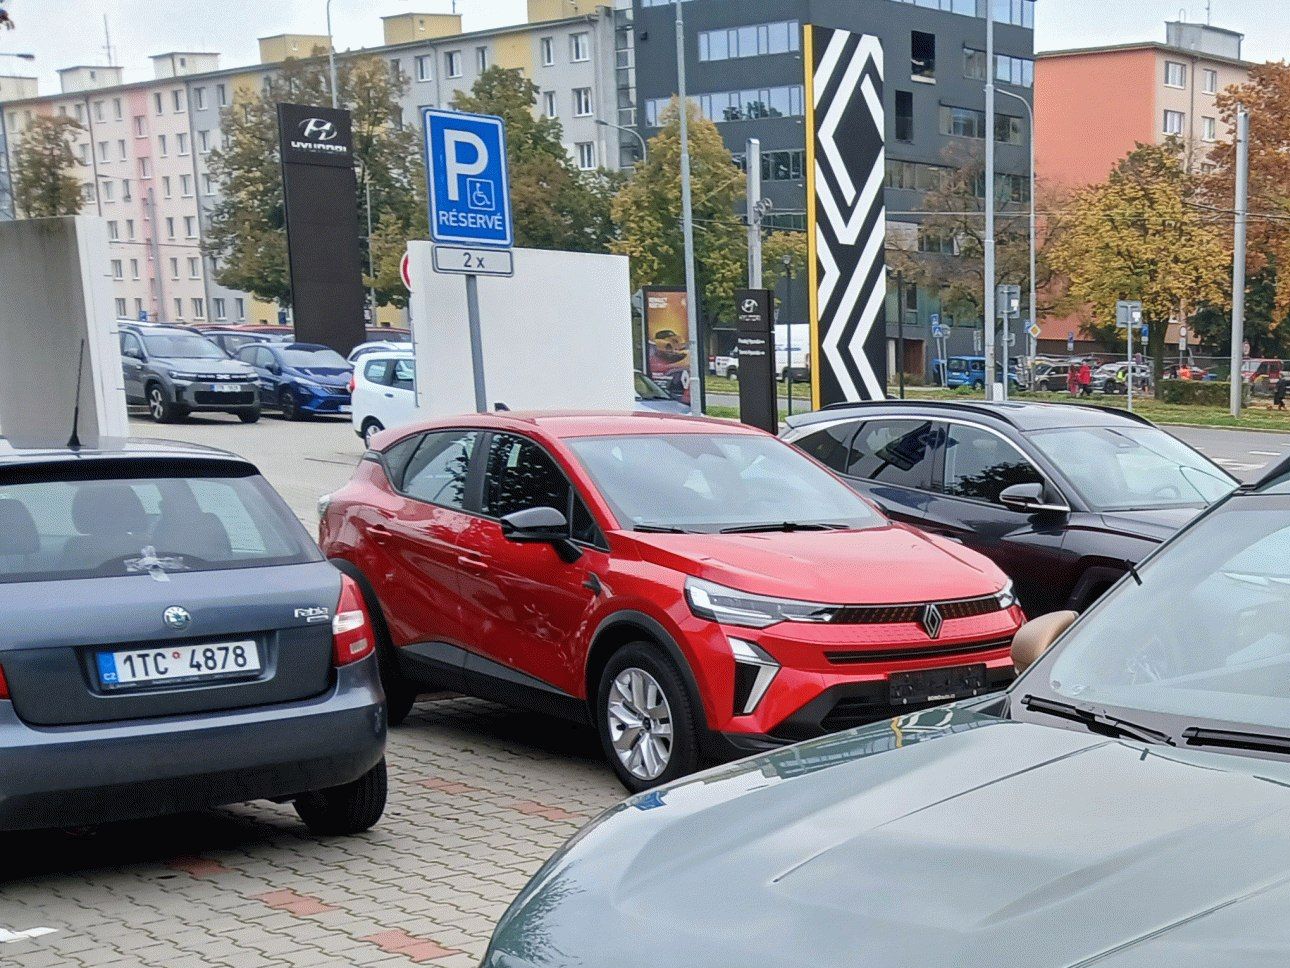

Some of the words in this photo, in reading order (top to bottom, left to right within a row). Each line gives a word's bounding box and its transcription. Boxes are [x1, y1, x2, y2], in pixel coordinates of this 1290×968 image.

[443, 128, 489, 202] P
[438, 208, 504, 231] RÉSERVÉ
[462, 252, 473, 268] 2
[476, 257, 486, 269] x
[123, 652, 169, 679] 1TC
[189, 645, 247, 672] 4878
